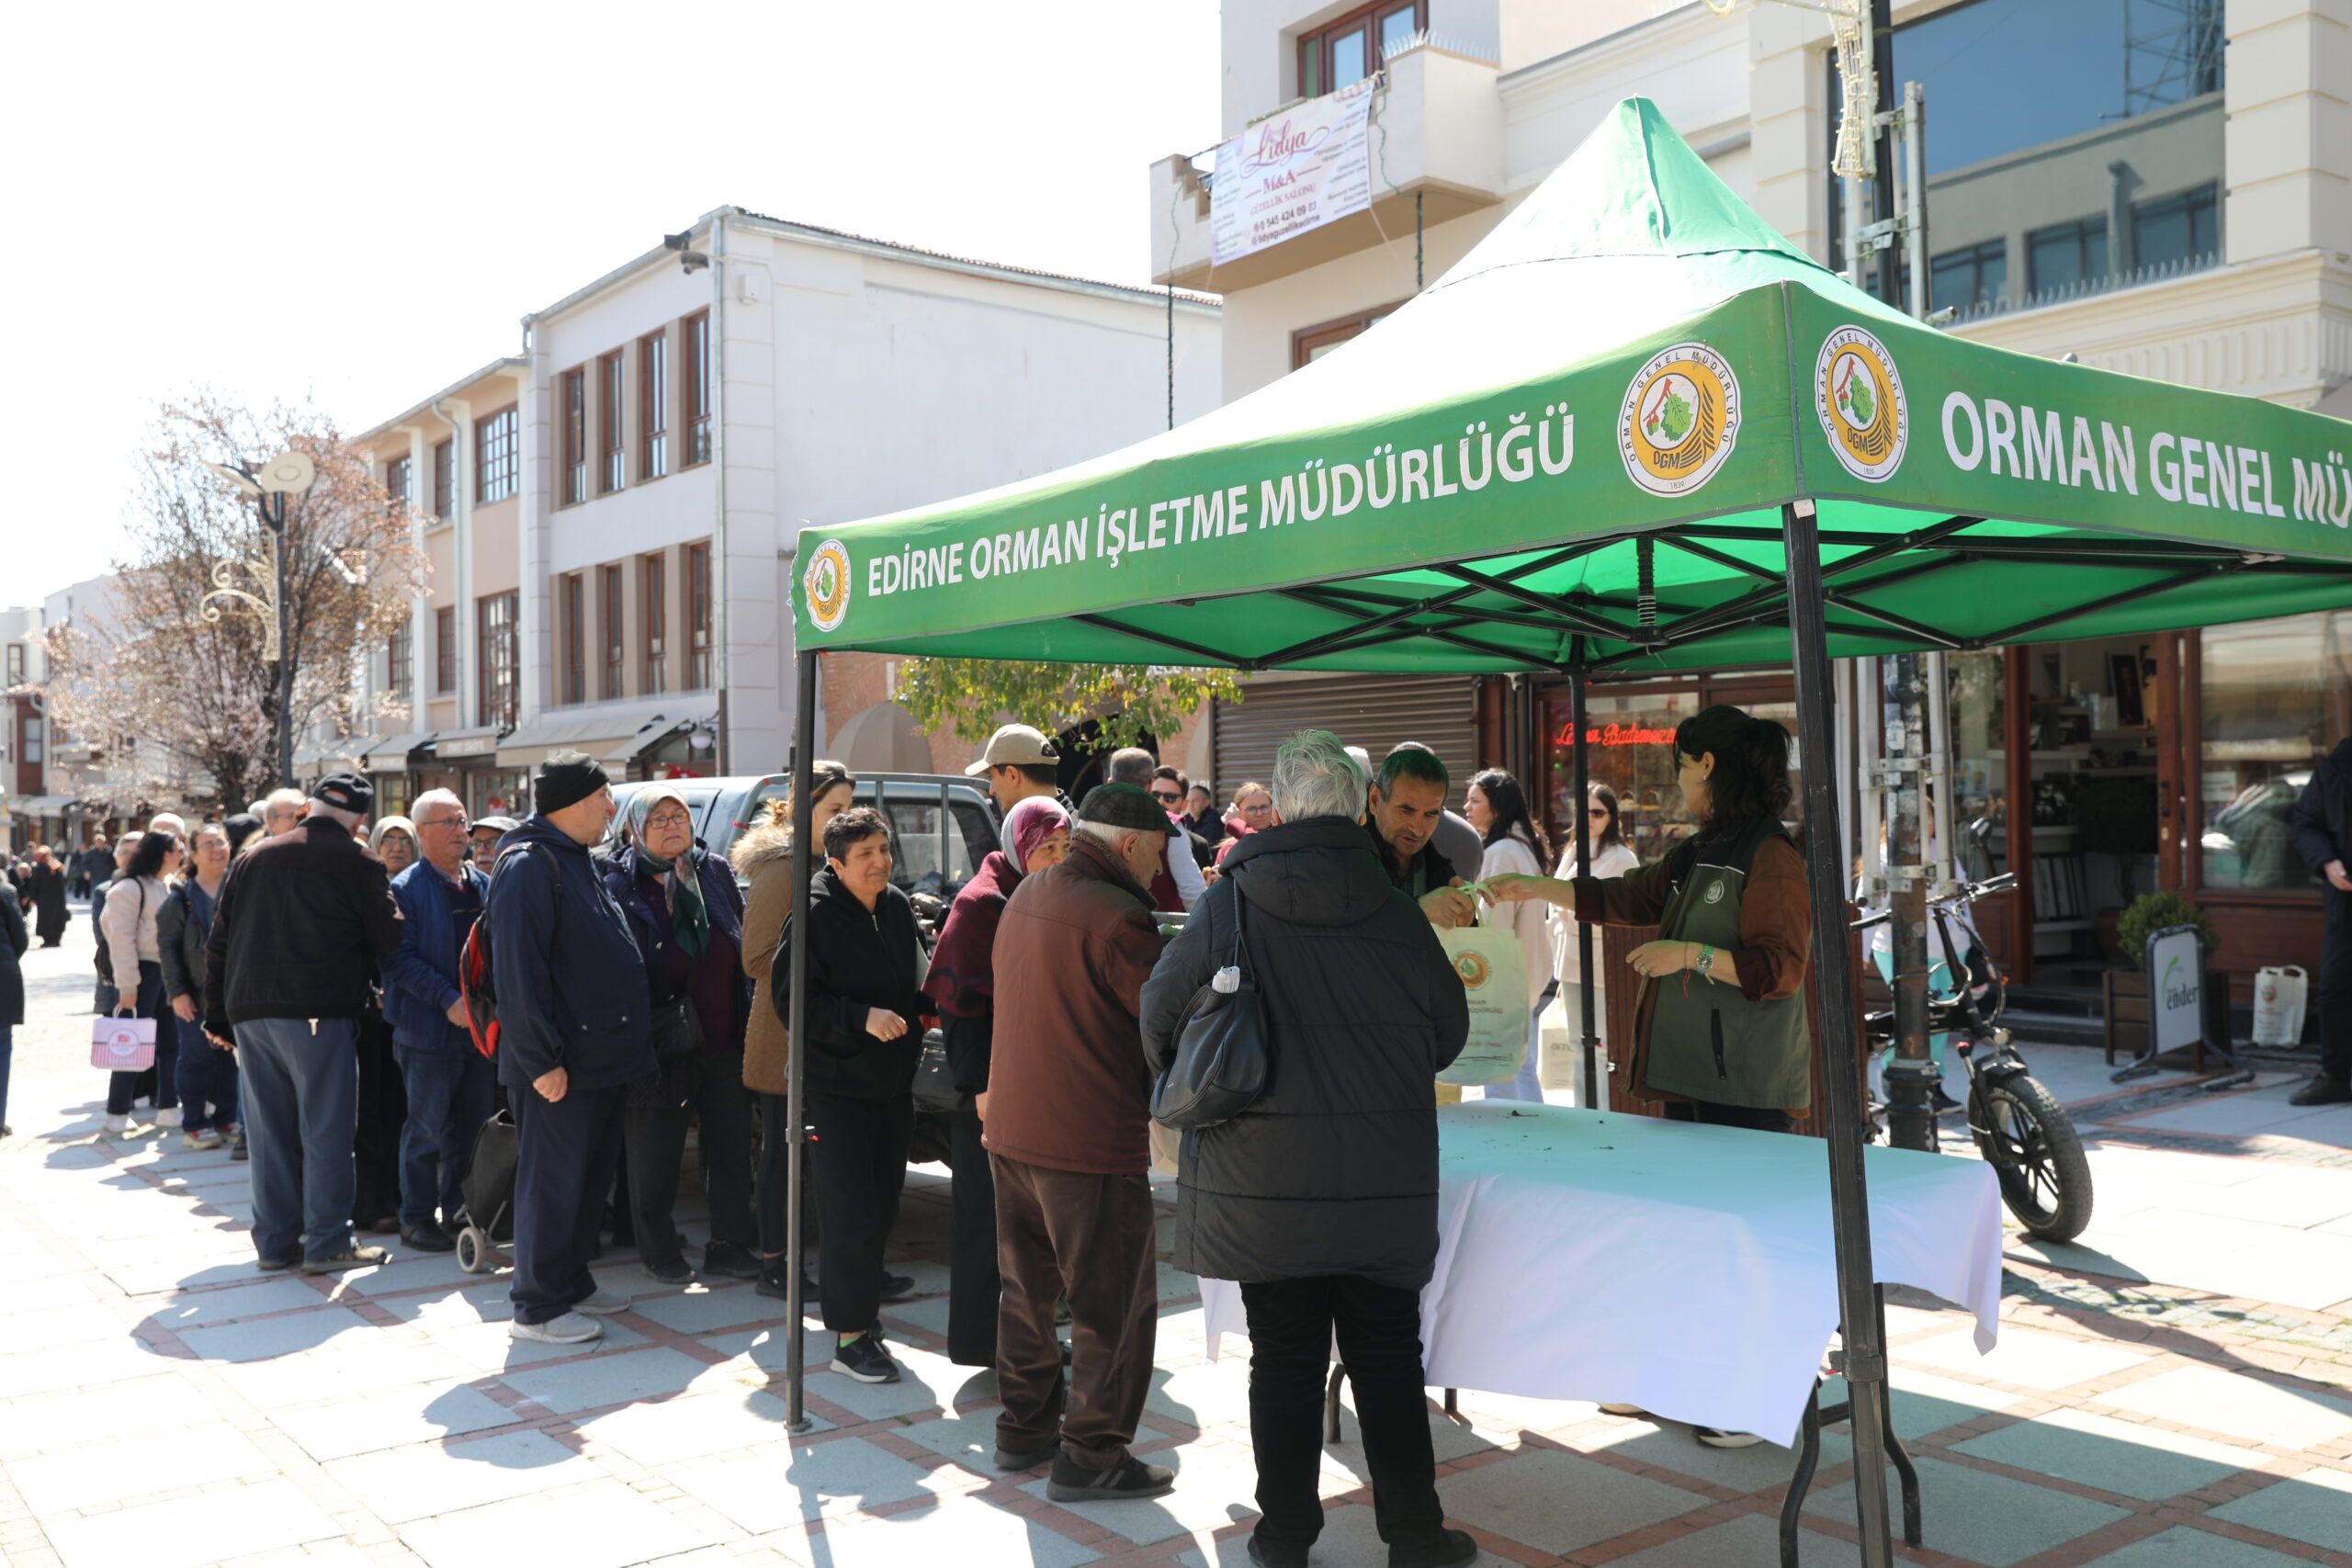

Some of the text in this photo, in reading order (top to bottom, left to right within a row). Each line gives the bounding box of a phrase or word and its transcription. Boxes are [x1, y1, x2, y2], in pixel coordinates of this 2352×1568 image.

[1240, 119, 1329, 179] Lidya
[1262, 169, 1296, 195] M&A
[1623, 350, 1735, 462] ORMAN GENEL MÜDÜRLÜĞÜ
[1820, 332, 1905, 444] ORMAN GENEL MÜDÜRLÜĞÜ
[1654, 450, 1681, 470] OGM
[1847, 427, 1869, 456] OGM
[1942, 391, 2139, 496] ORMAN
[2148, 432, 2286, 518] GENEL
[867, 543, 965, 598] EDİRNE
[969, 518, 1086, 581] ORMAN
[1096, 483, 1248, 570] İŞLETME
[1259, 401, 1575, 530] MÜDÜRLÜĞÜ
[1669, 480, 1685, 490] 1839
